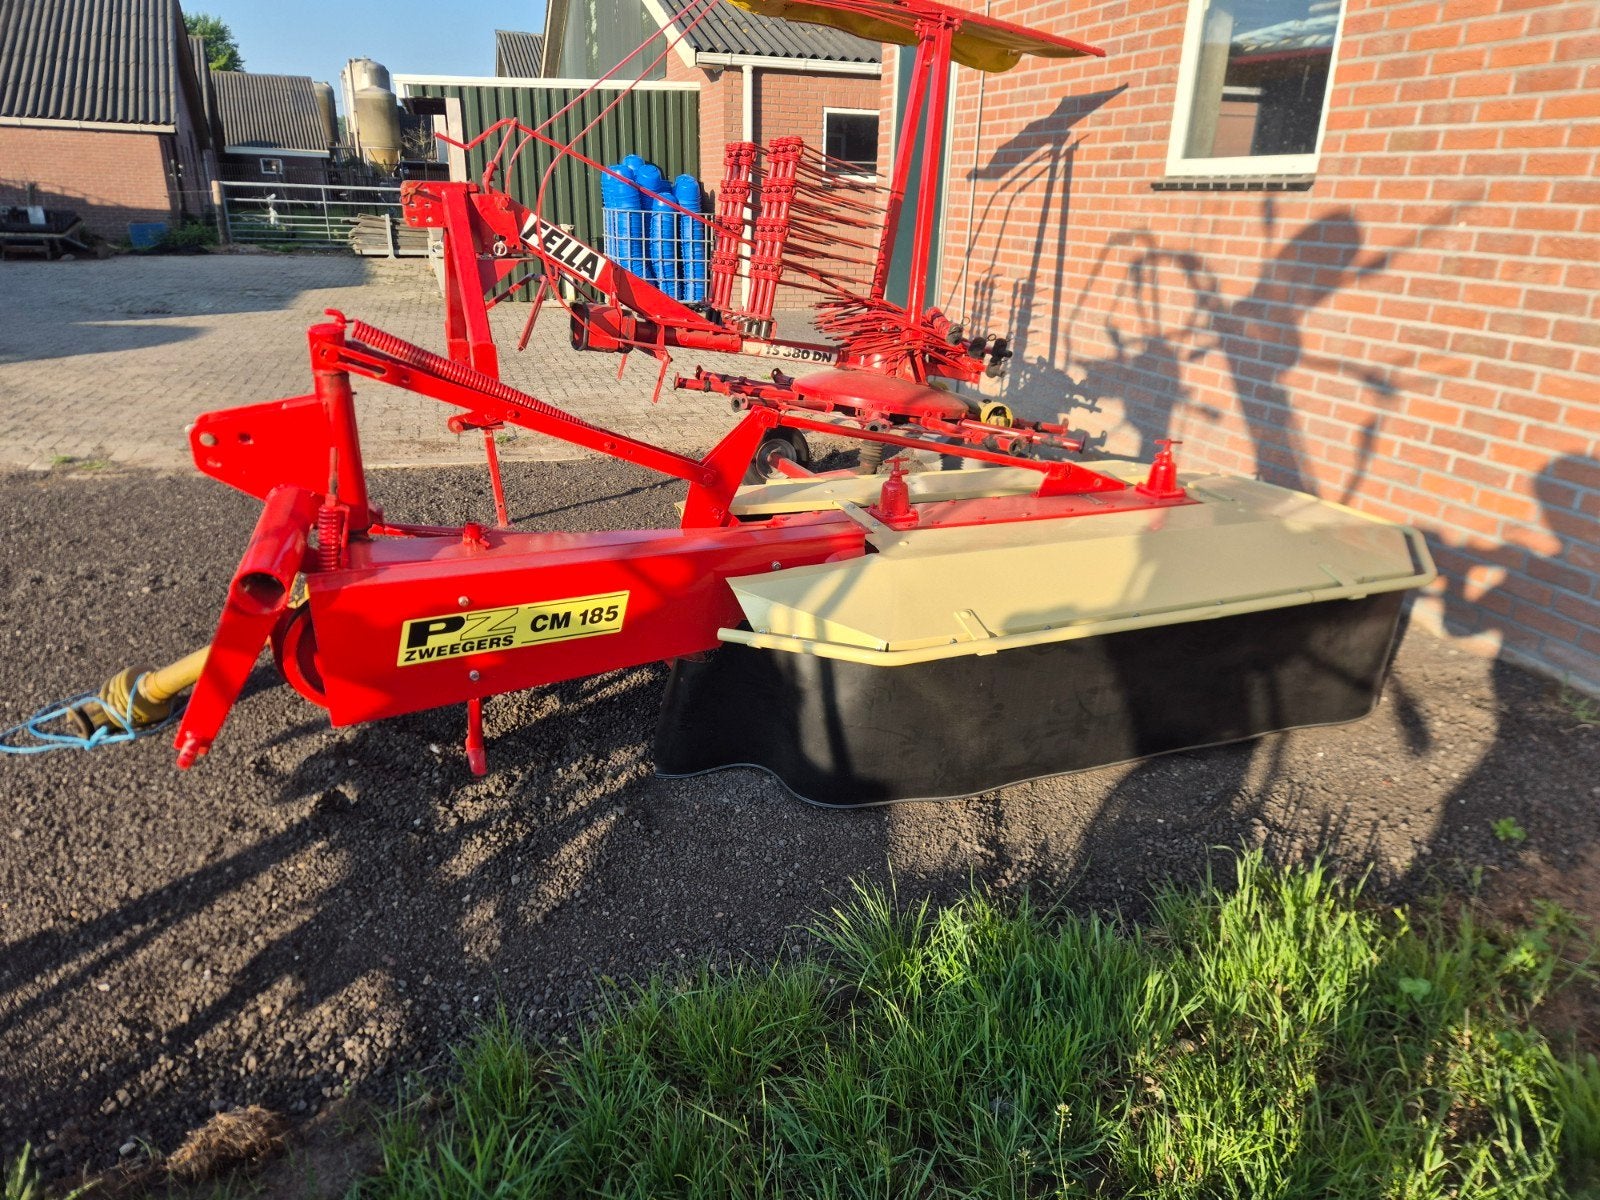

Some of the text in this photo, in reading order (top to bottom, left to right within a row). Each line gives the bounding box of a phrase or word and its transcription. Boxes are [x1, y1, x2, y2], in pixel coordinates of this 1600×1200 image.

[521, 221, 599, 280] FELLA
[812, 350, 832, 363] DN
[406, 607, 519, 649] PZ
[530, 605, 619, 633] CM 185
[404, 635, 514, 662] ZWEEGERS
